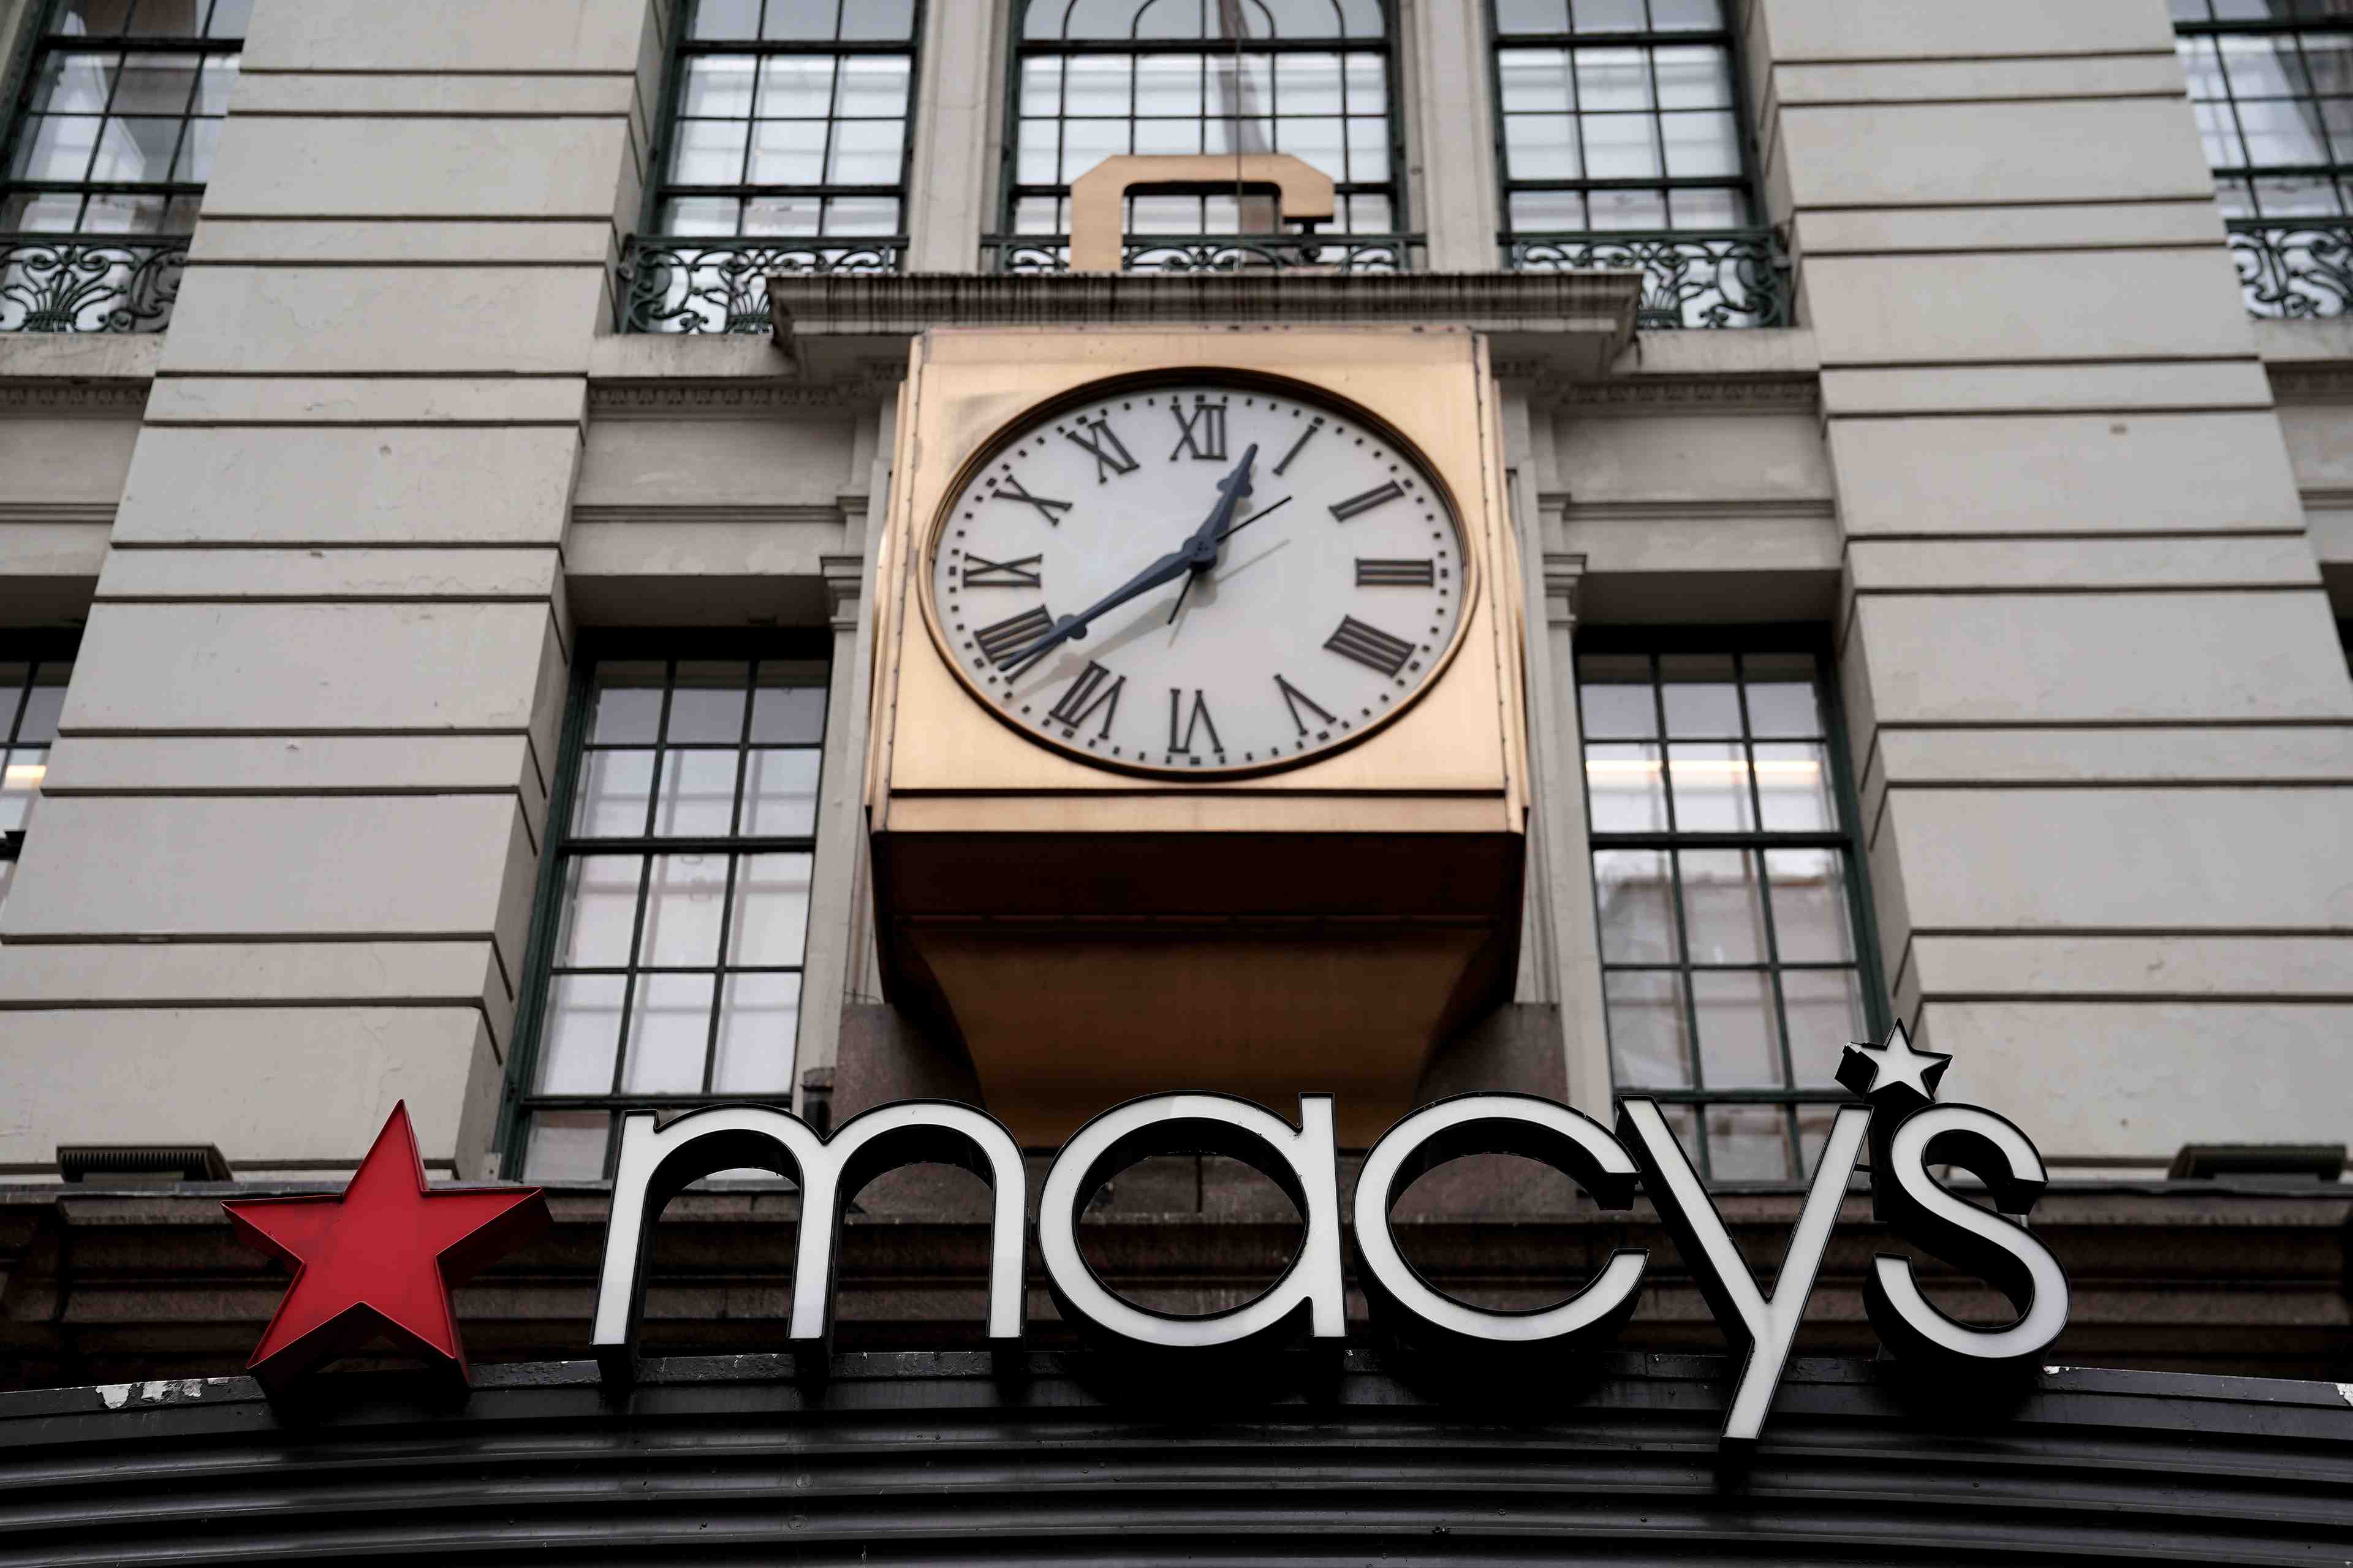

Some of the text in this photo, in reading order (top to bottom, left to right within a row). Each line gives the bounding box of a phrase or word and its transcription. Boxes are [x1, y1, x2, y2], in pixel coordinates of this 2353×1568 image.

[1066, 420, 1140, 483] XI
[1171, 404, 1228, 461] XII
[993, 475, 1073, 526] X
[1328, 481, 1405, 522] II
[963, 553, 1044, 588] IX
[1355, 558, 1434, 588] III
[1048, 660, 1126, 740] VII
[1169, 688, 1223, 754] VI
[1274, 675, 1336, 735] V
